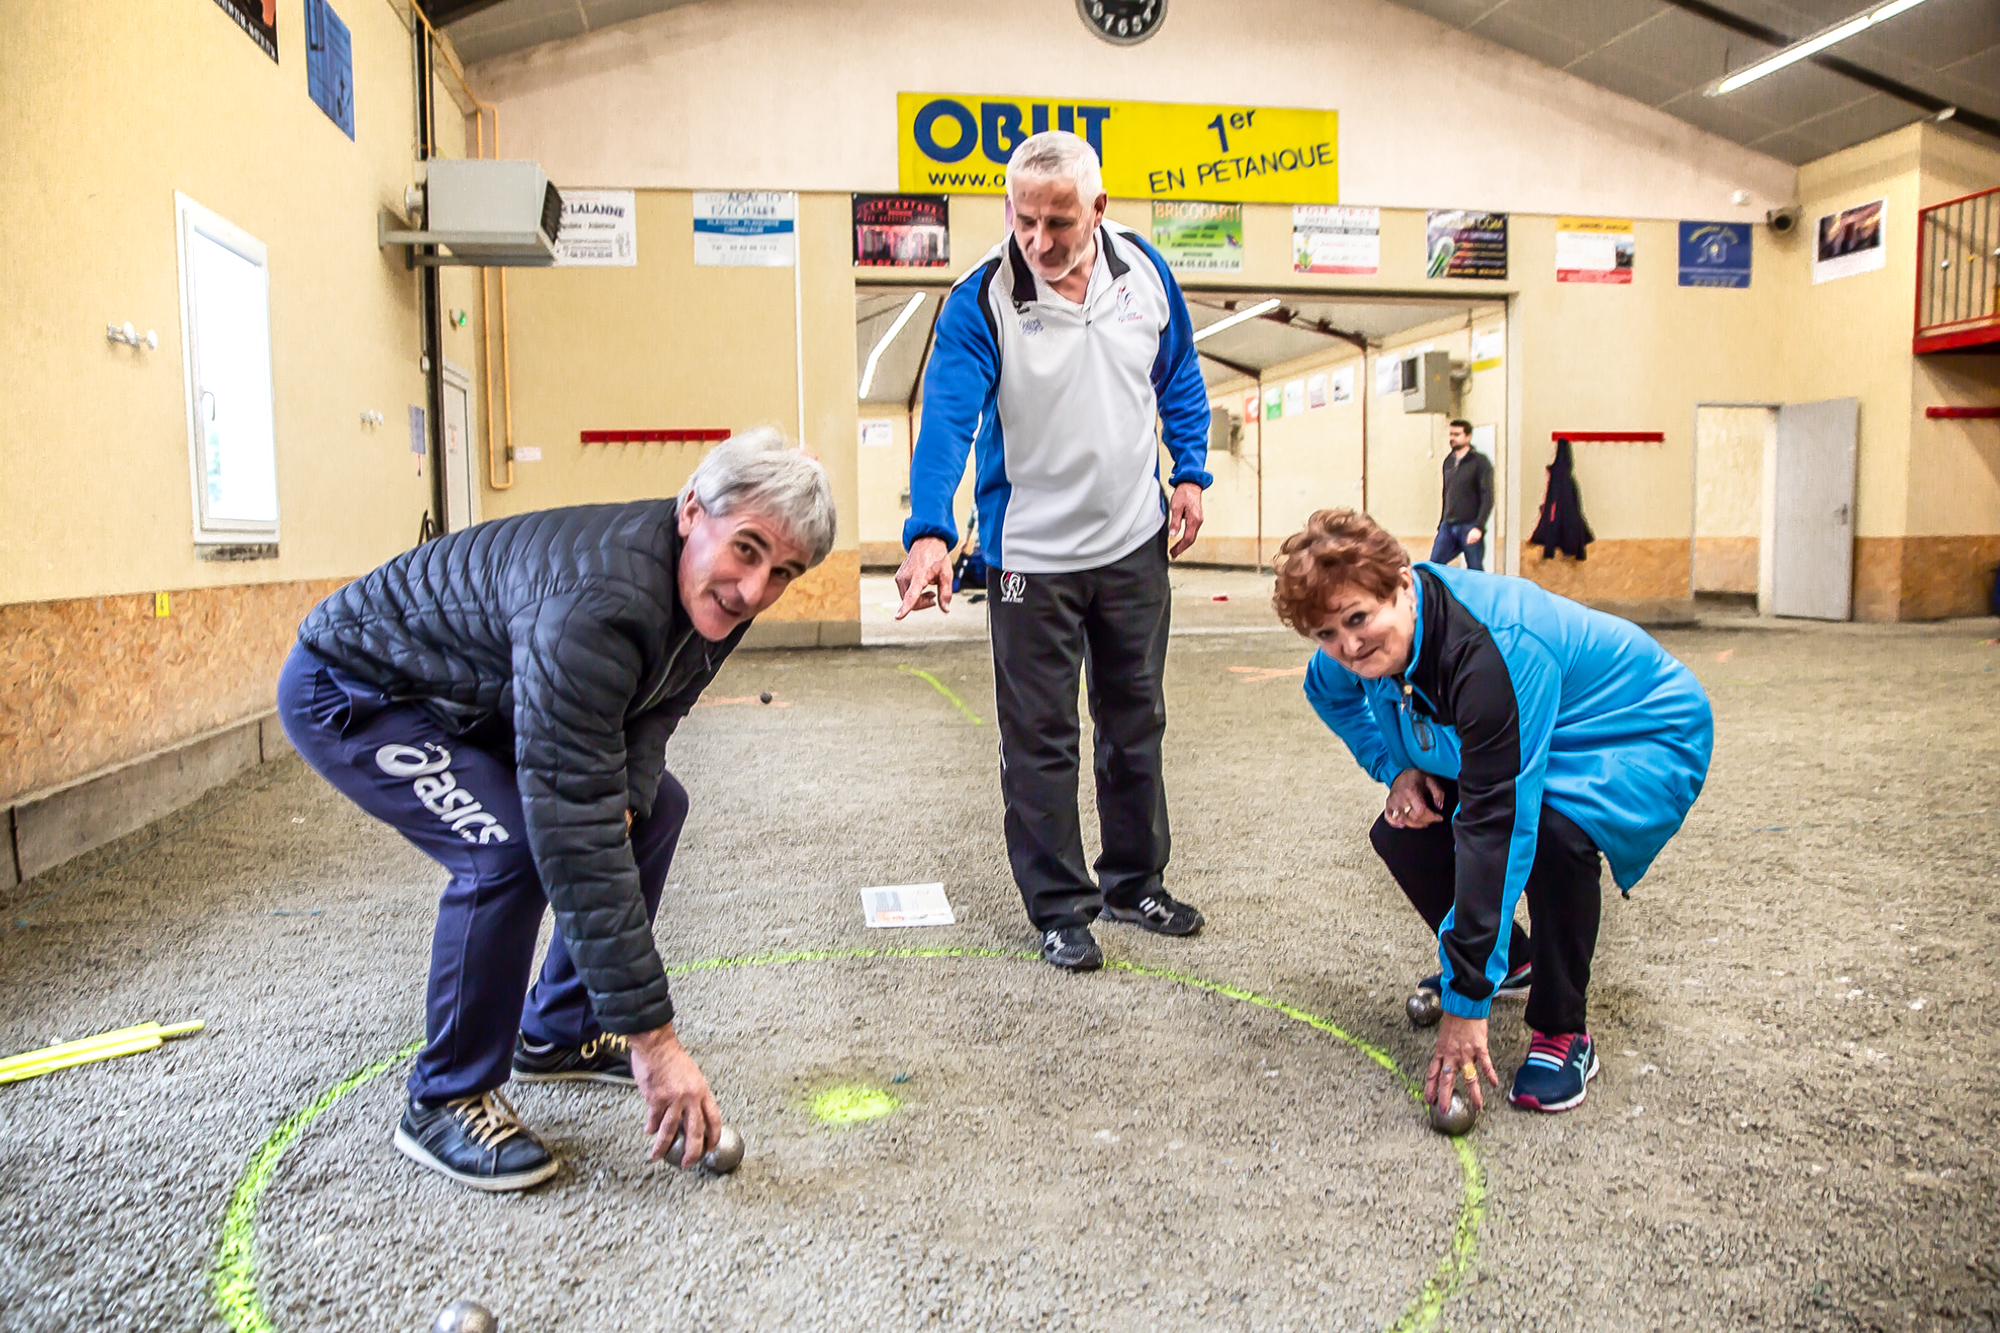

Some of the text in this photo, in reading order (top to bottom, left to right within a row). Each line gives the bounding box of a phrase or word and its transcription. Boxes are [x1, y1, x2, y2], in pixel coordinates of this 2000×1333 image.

[1118, 18, 1128, 36] 6
[1148, 167, 1186, 194] EN
[412, 770, 510, 845] asics
